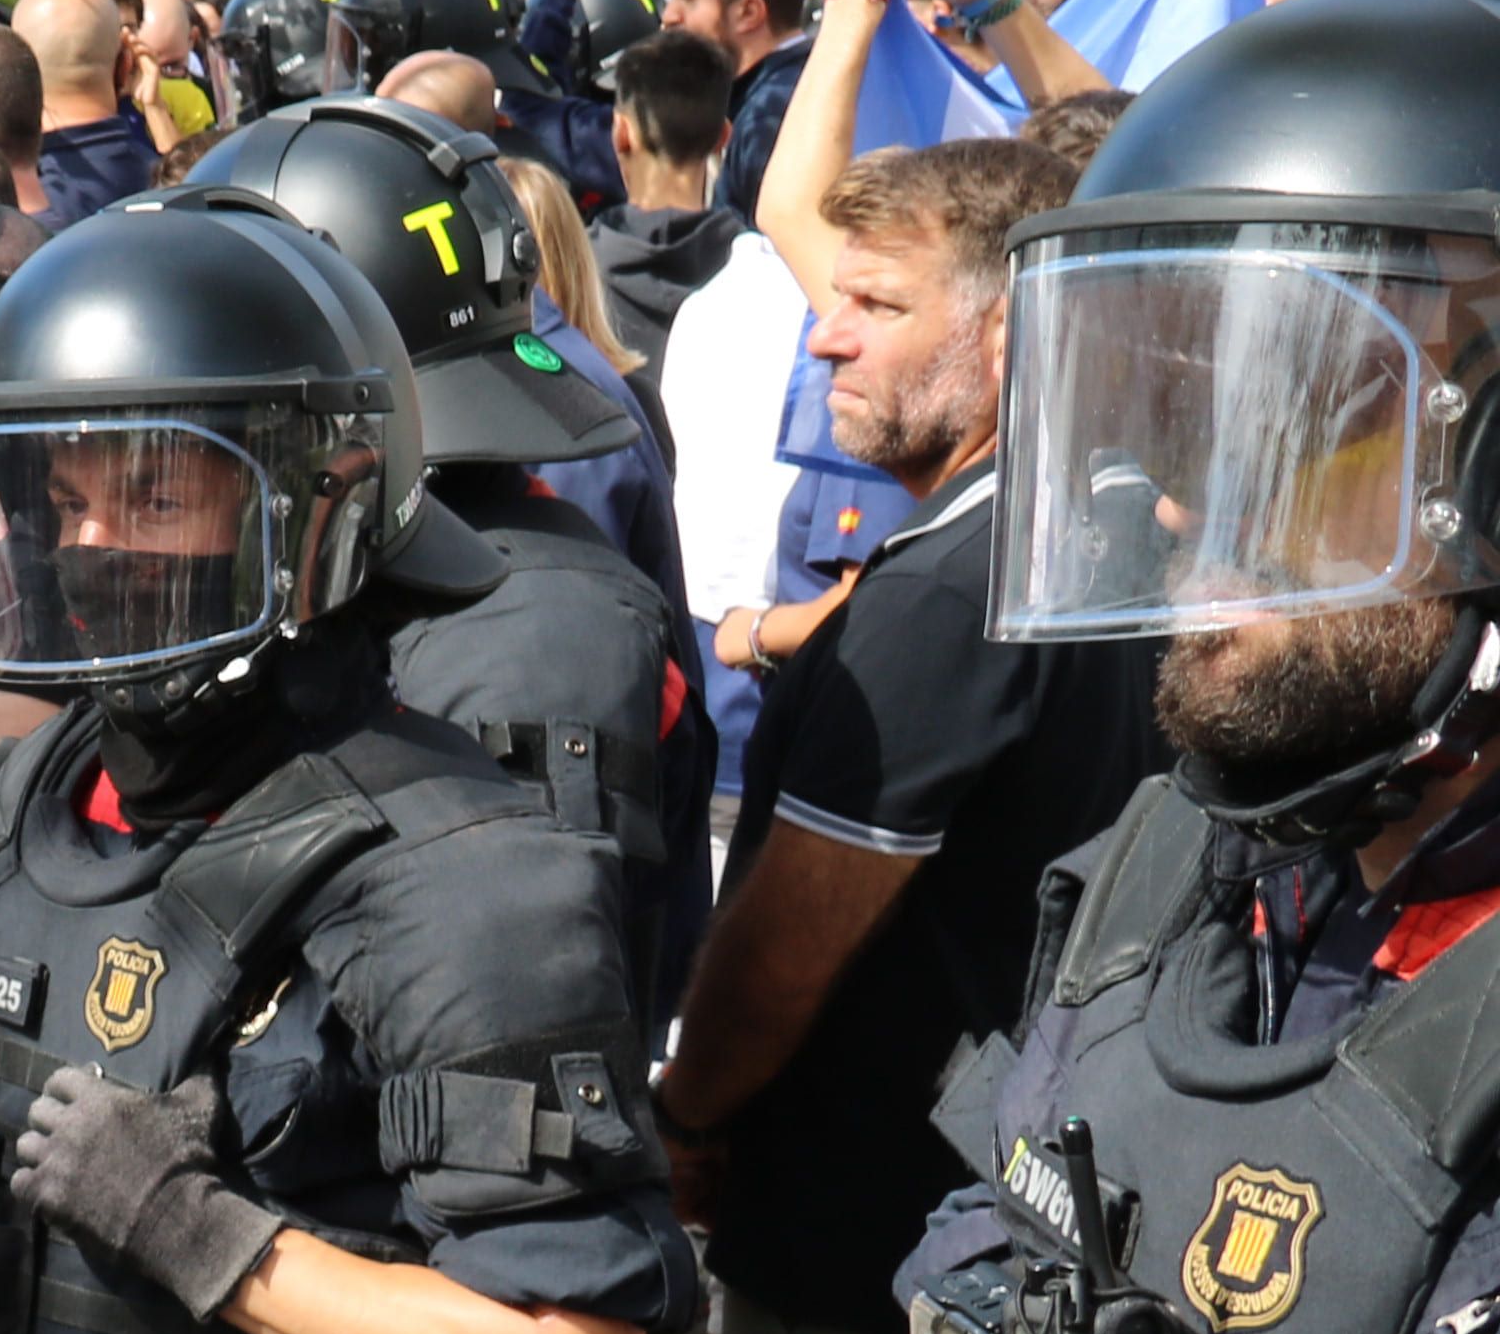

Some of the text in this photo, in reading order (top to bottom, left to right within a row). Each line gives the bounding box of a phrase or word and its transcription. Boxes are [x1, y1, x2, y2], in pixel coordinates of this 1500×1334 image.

[402, 201, 460, 276] T
[449, 305, 475, 328] 861
[1003, 1136, 1083, 1247] T6W61
[1226, 1179, 1302, 1222] POLICIA
